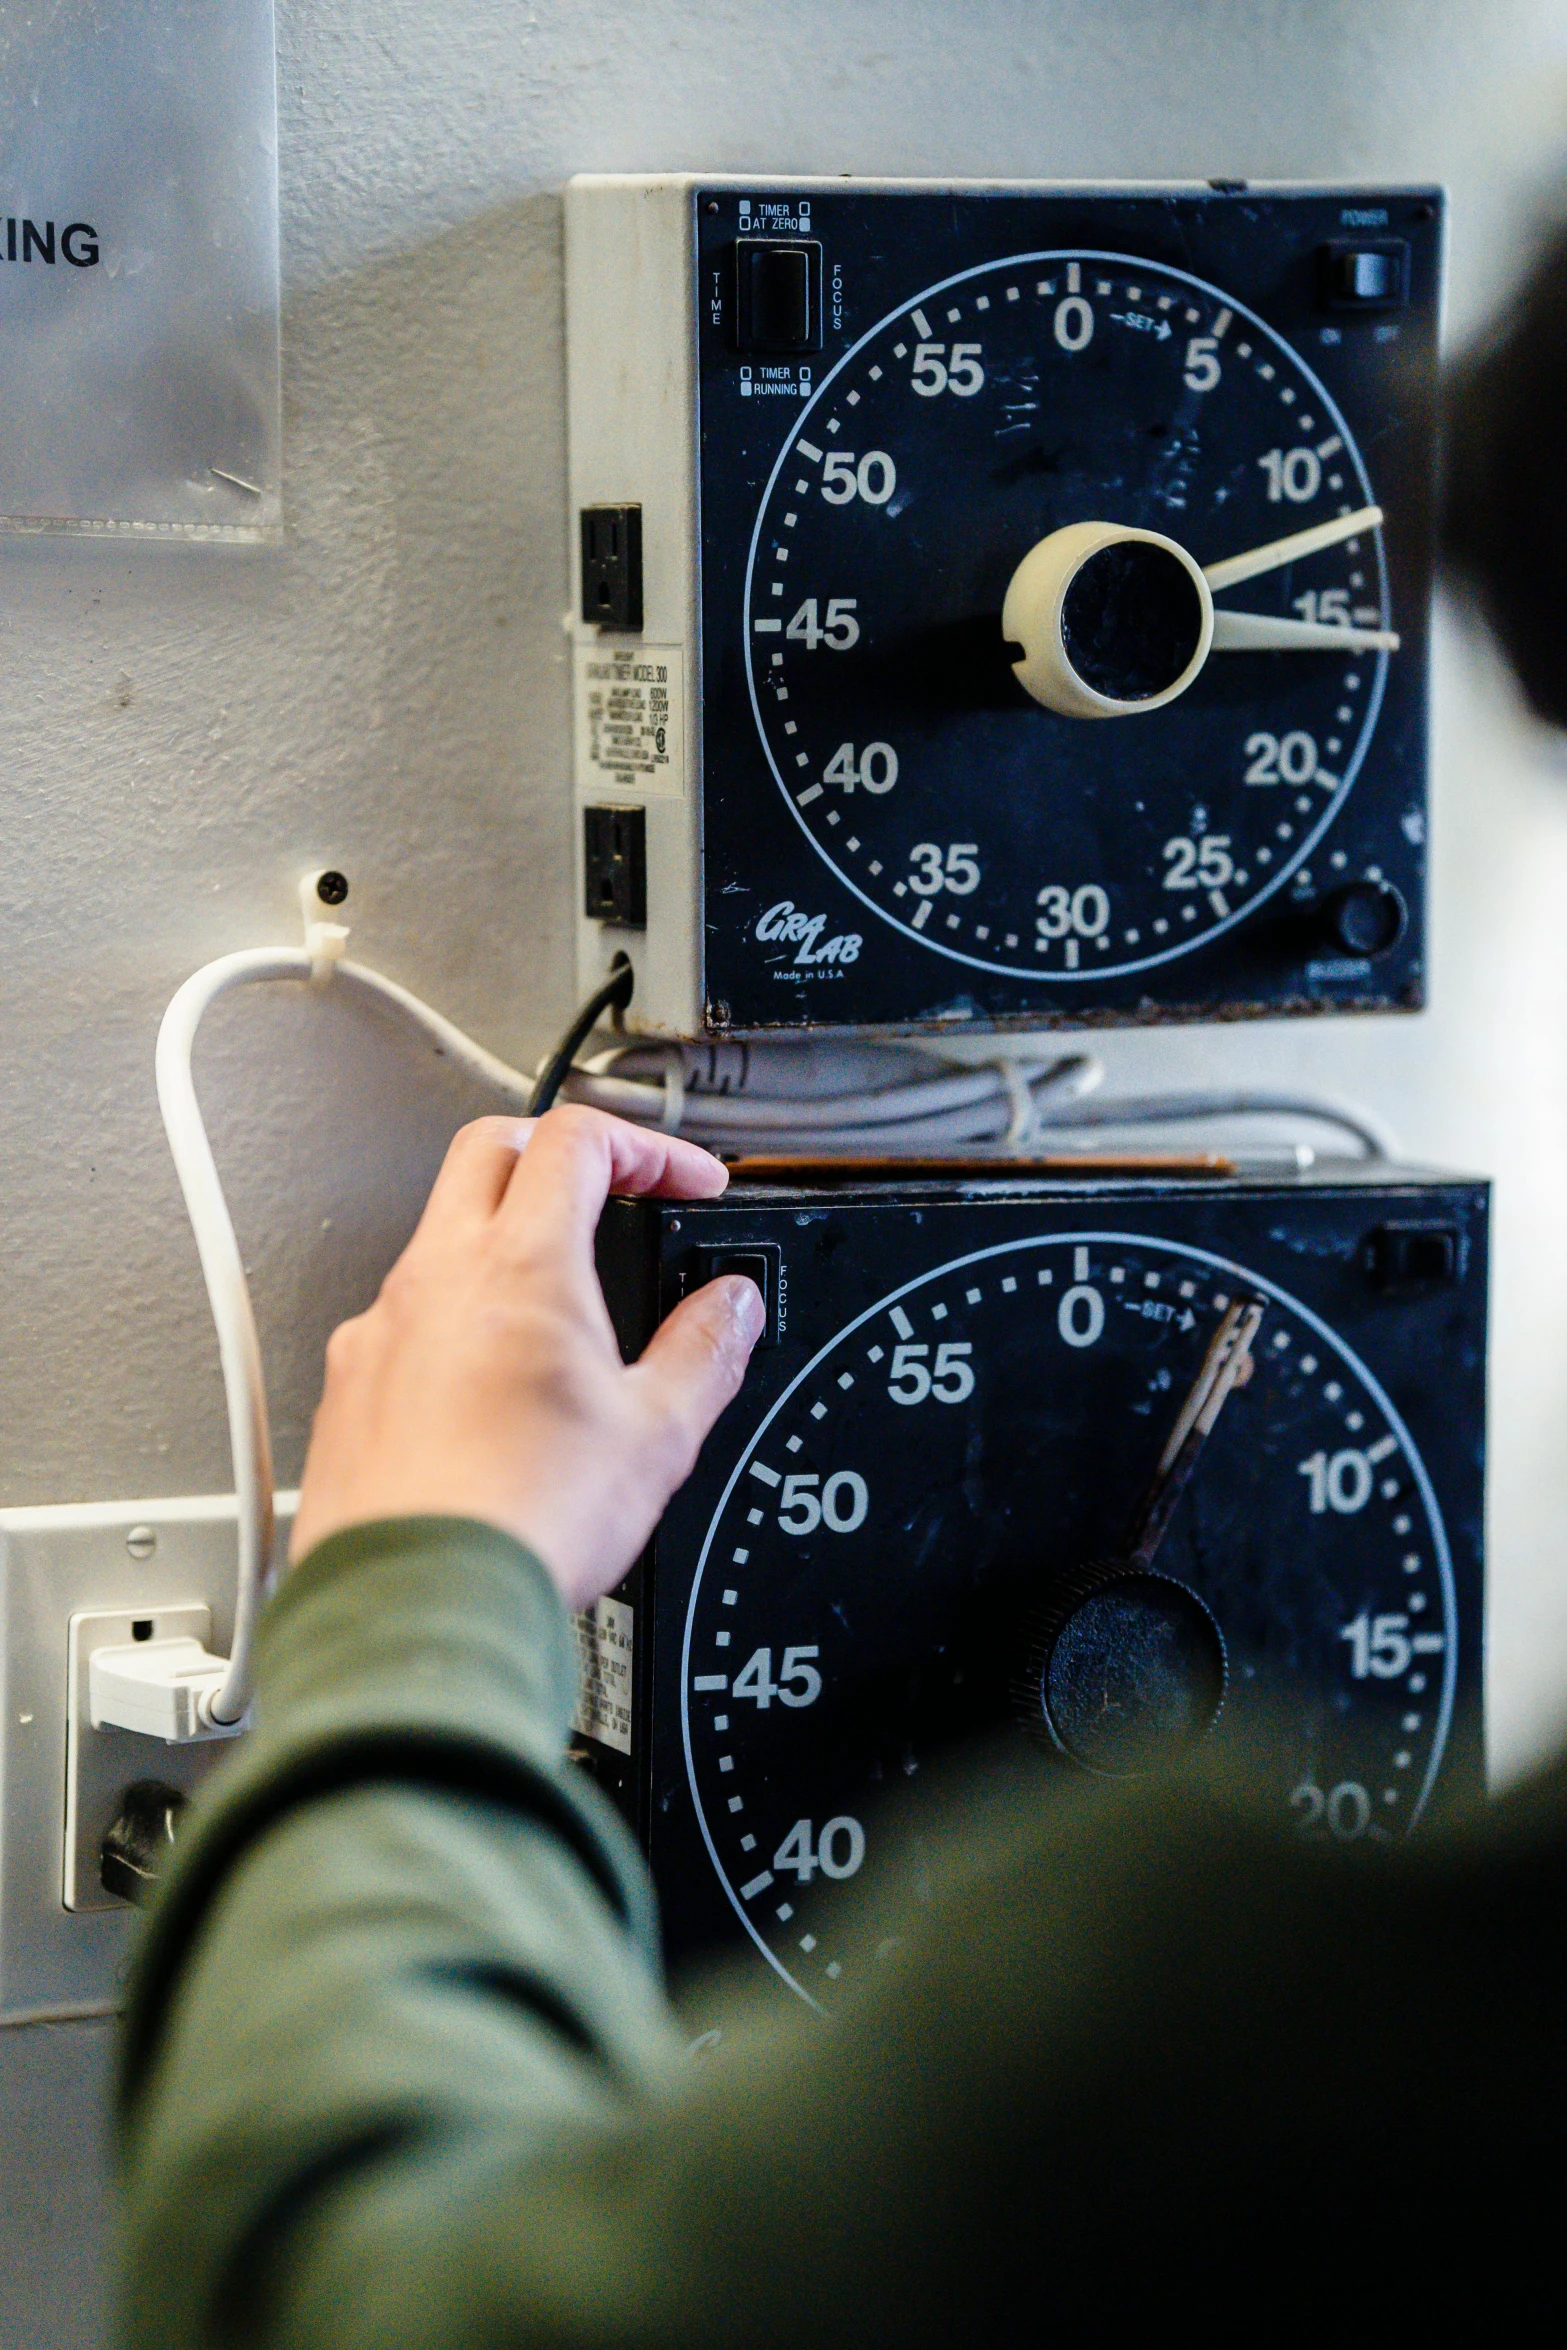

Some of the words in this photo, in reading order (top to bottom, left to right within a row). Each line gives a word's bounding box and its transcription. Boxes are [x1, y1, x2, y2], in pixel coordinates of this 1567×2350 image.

[753, 218, 767, 231] AT
[772, 217, 798, 231] ZERO
[758, 204, 790, 217] TIMER
[0, 217, 100, 268] ING
[711, 272, 722, 325] TIME
[832, 264, 842, 330] FOCUS
[1053, 296, 1095, 352] 0
[753, 382, 798, 397] RUNNING
[759, 367, 791, 380] TIMER
[910, 342, 985, 397] 55
[1183, 337, 1222, 392] 5
[820, 450, 897, 505] 50
[1256, 447, 1322, 503] 10
[786, 598, 861, 651] 45
[656, 665, 668, 683] 300
[823, 741, 898, 794] 40
[1244, 731, 1318, 786] 20
[907, 842, 981, 896] 35
[1162, 836, 1234, 891] 25
[1035, 884, 1111, 938] 30
[773, 970, 801, 981] Made
[805, 969, 814, 980] in
[777, 1265, 788, 1332] FOCUS
[1057, 1285, 1105, 1348] 0
[887, 1342, 976, 1406] 55
[777, 1470, 869, 1536] 50
[1298, 1447, 1373, 1515] 10
[1338, 1610, 1412, 1680] 15
[732, 1645, 823, 1710] 45
[773, 1815, 866, 1882] 40
